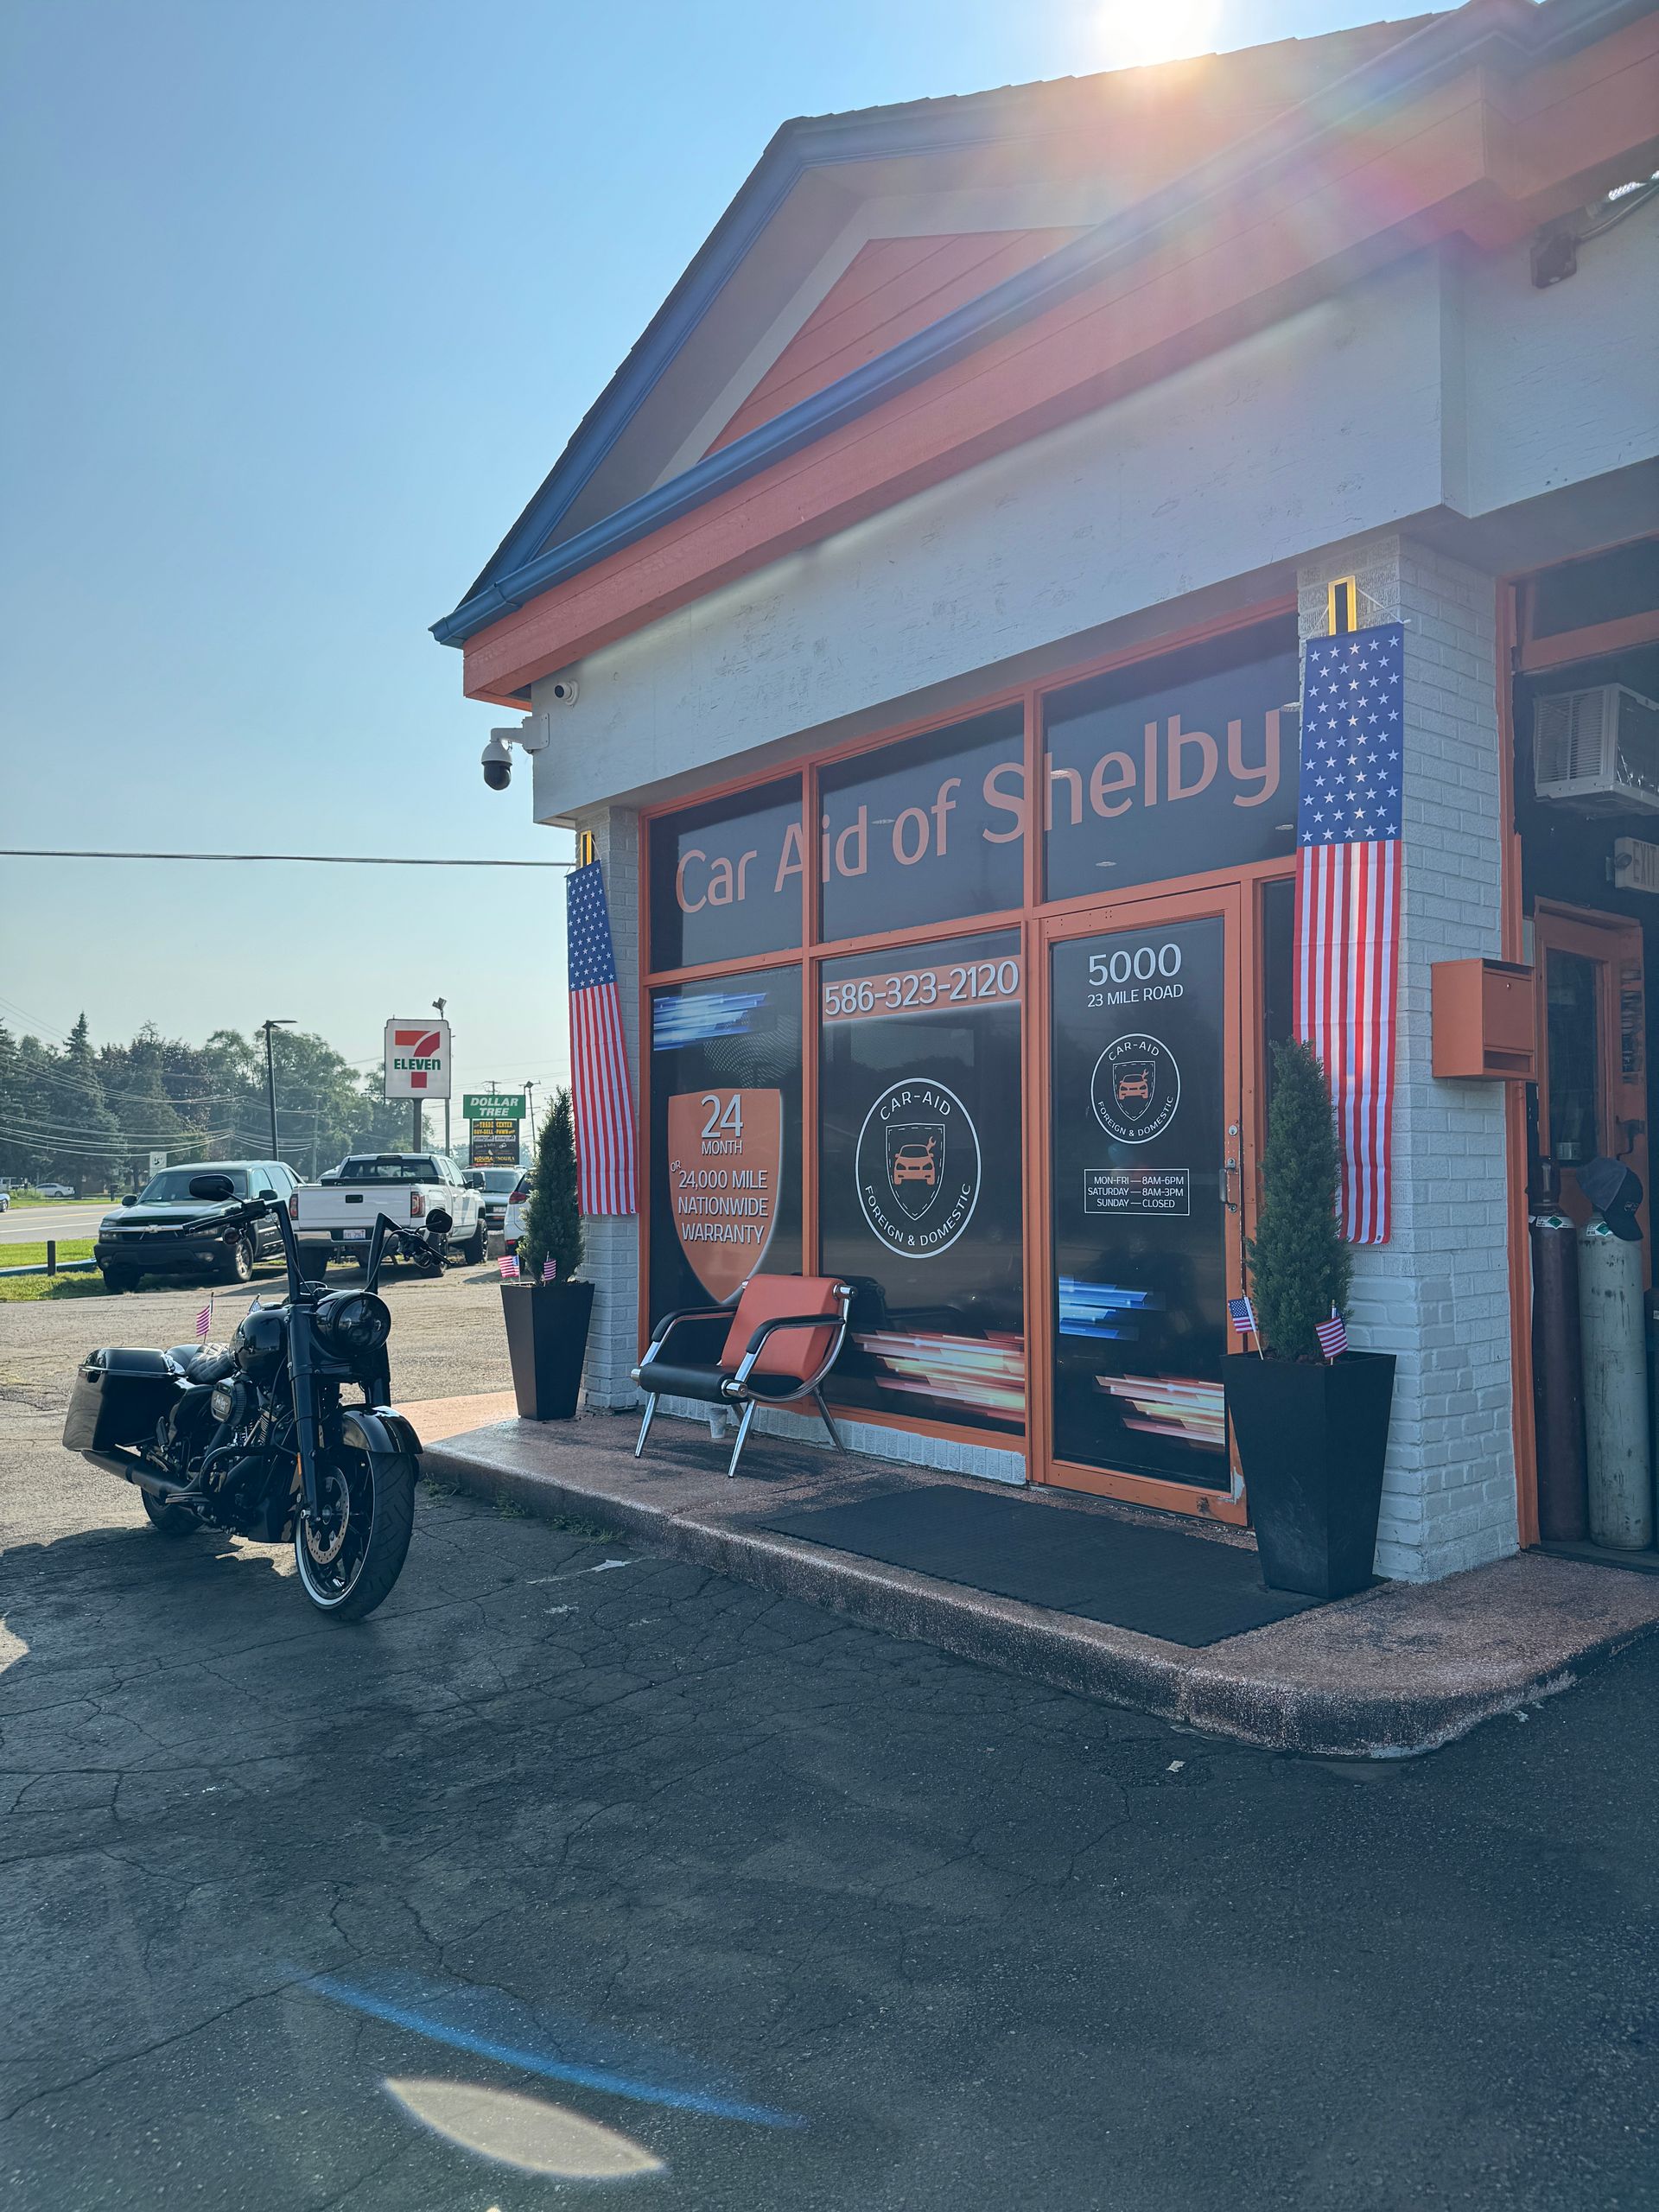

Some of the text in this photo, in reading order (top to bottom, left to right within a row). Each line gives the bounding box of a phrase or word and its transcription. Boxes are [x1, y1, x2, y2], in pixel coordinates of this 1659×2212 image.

[676, 708, 1281, 913] Car Aid of Shelby
[1088, 943, 1182, 987] 5000
[824, 960, 1020, 1016] 586-323-2120
[1087, 983, 1184, 1007] 23 MILE ROAD
[1108, 1041, 1160, 1061] CAR-AID
[470, 1097, 519, 1107] DOLLAR
[480, 1107, 510, 1116] TREE
[880, 1090, 951, 1121] CAR-AID
[701, 1094, 744, 1138] 24
[1097, 1101, 1127, 1135] FOREIGN
[1137, 1096, 1173, 1136] DOMESTIC
[702, 1140, 743, 1155] MONTH
[670, 1160, 682, 1173] OR
[678, 1170, 768, 1191] 24,000 MILE
[1094, 1176, 1185, 1185] MON-FRI 8AM-6PM
[1087, 1187, 1184, 1197] SATURDAY 8AM-3PM
[677, 1196, 769, 1217] NATIONWIDE
[1096, 1198, 1175, 1208] SUNDAY CLOSED
[864, 1182, 971, 1246] FOREIGN & DOMESTIC
[681, 1223, 765, 1244] WARRANTY
